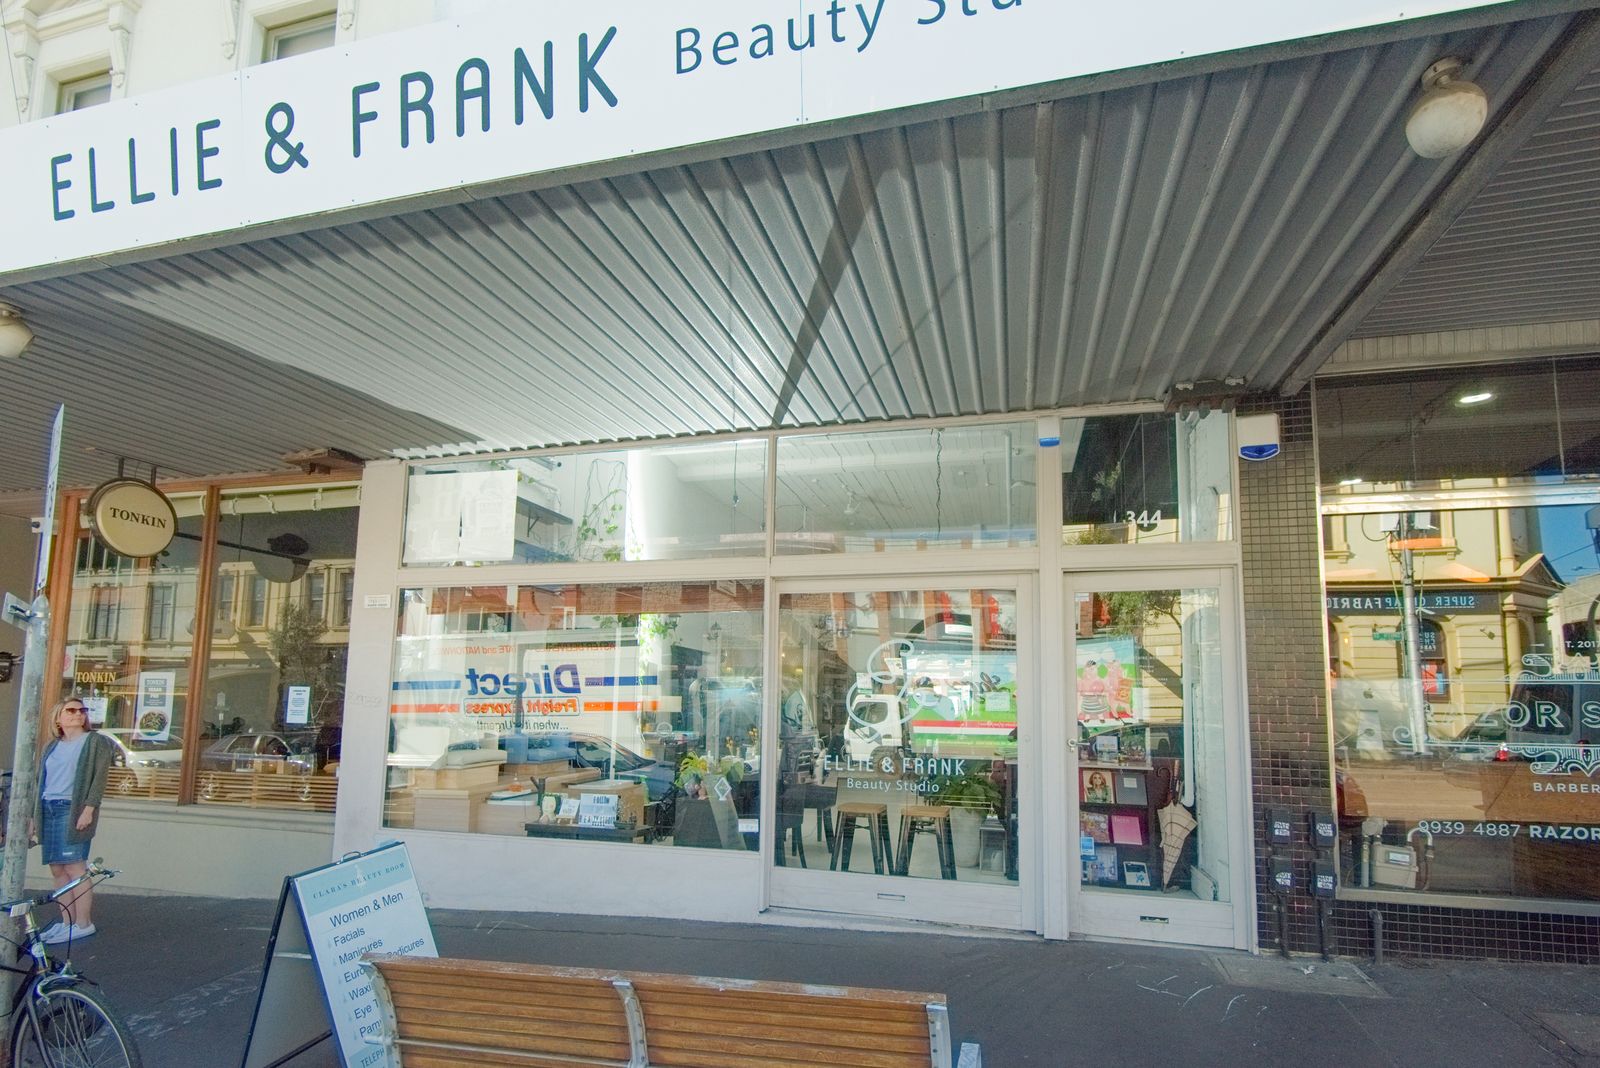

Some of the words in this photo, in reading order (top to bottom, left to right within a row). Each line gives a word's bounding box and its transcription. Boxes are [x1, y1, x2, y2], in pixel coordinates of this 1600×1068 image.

[675, 0, 886, 75] Beauty
[50, 118, 223, 221] ELLIE
[264, 102, 309, 174] &
[352, 26, 619, 158] FRANK
[110, 507, 167, 529] TONKIN
[1126, 509, 1162, 530] 344
[76, 671, 117, 683] TONKIN
[824, 754, 875, 772] ELLIE
[881, 756, 895, 774] &
[902, 757, 966, 776] FRANK
[846, 778, 892, 793] Beauty
[895, 779, 940, 793] Studio
[1473, 823, 1520, 837] 4887
[329, 904, 372, 928] Women
[373, 898, 381, 911] &
[382, 891, 404, 907] Men
[333, 926, 366, 947] Facials
[338, 938, 384, 965] Manicures
[354, 1004, 372, 1020] Eye
[359, 1019, 382, 1038] Pam
